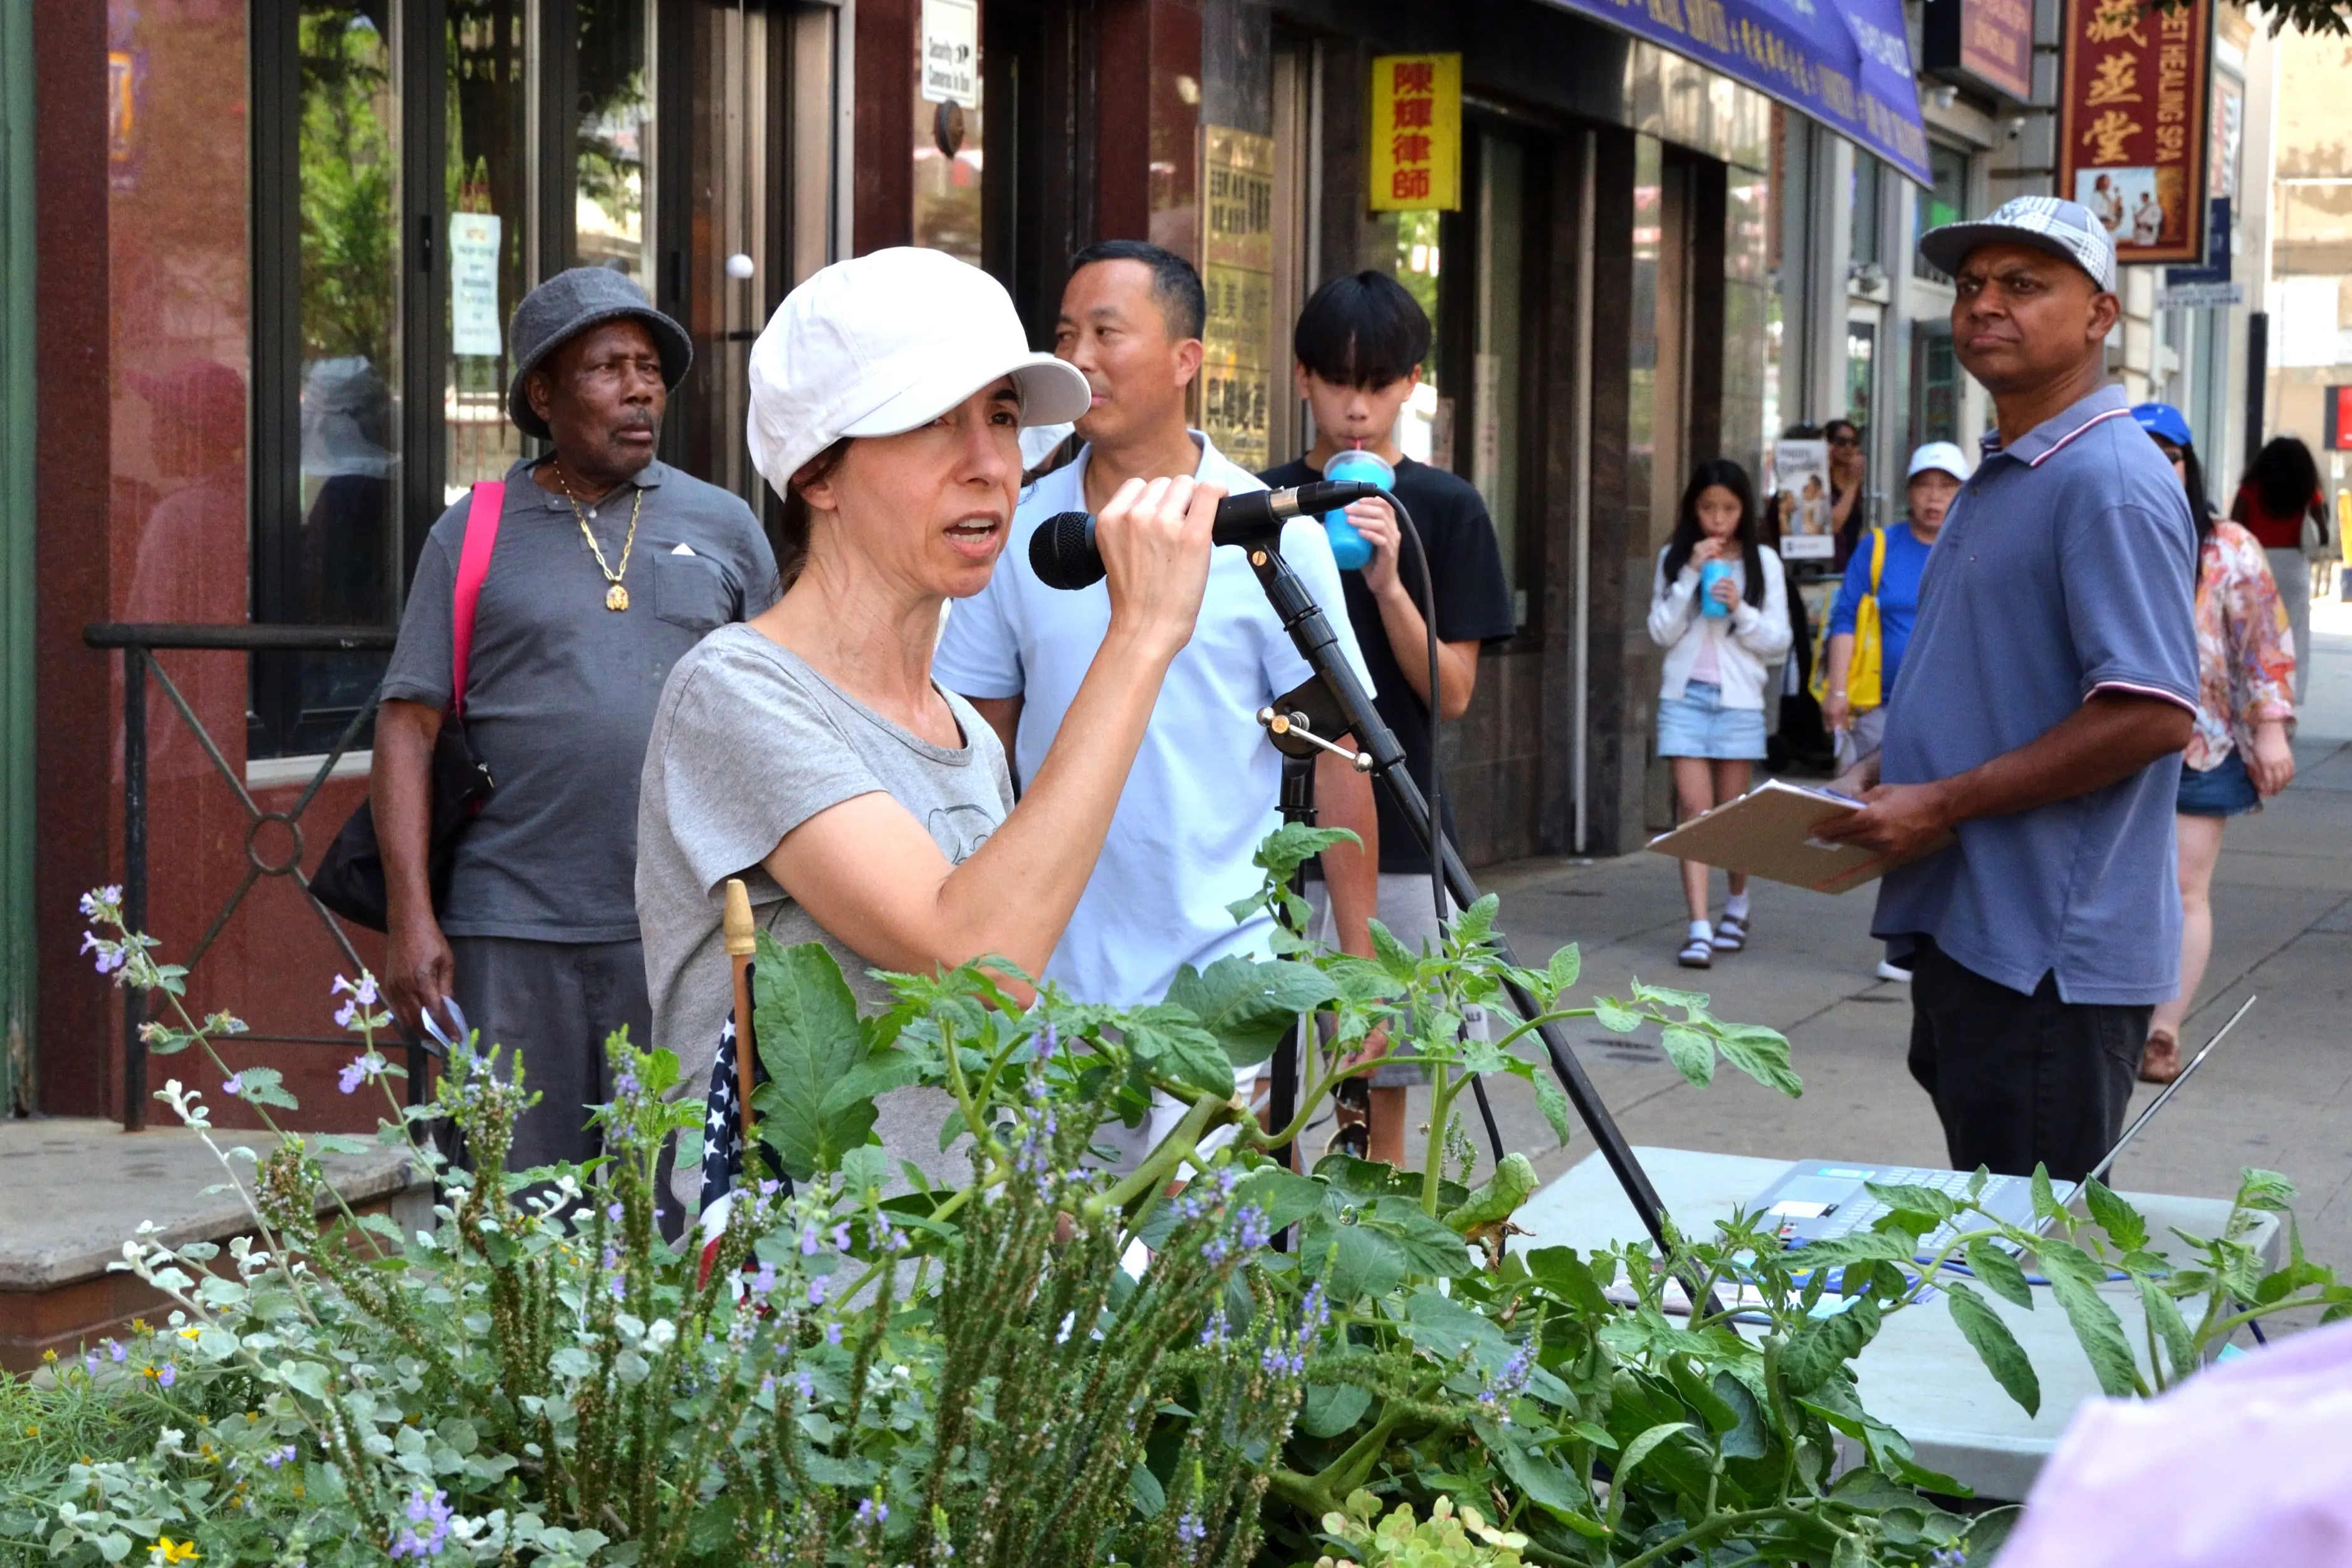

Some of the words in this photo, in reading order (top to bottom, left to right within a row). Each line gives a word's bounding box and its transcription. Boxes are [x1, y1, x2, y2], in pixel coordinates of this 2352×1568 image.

[928, 36, 953, 66] Security
[928, 63, 953, 89] Cameras
[953, 71, 959, 91] in
[2156, 44, 2187, 122] HEALING
[1391, 62, 1434, 201] 陳輝律師
[2155, 125, 2185, 162] SPA
